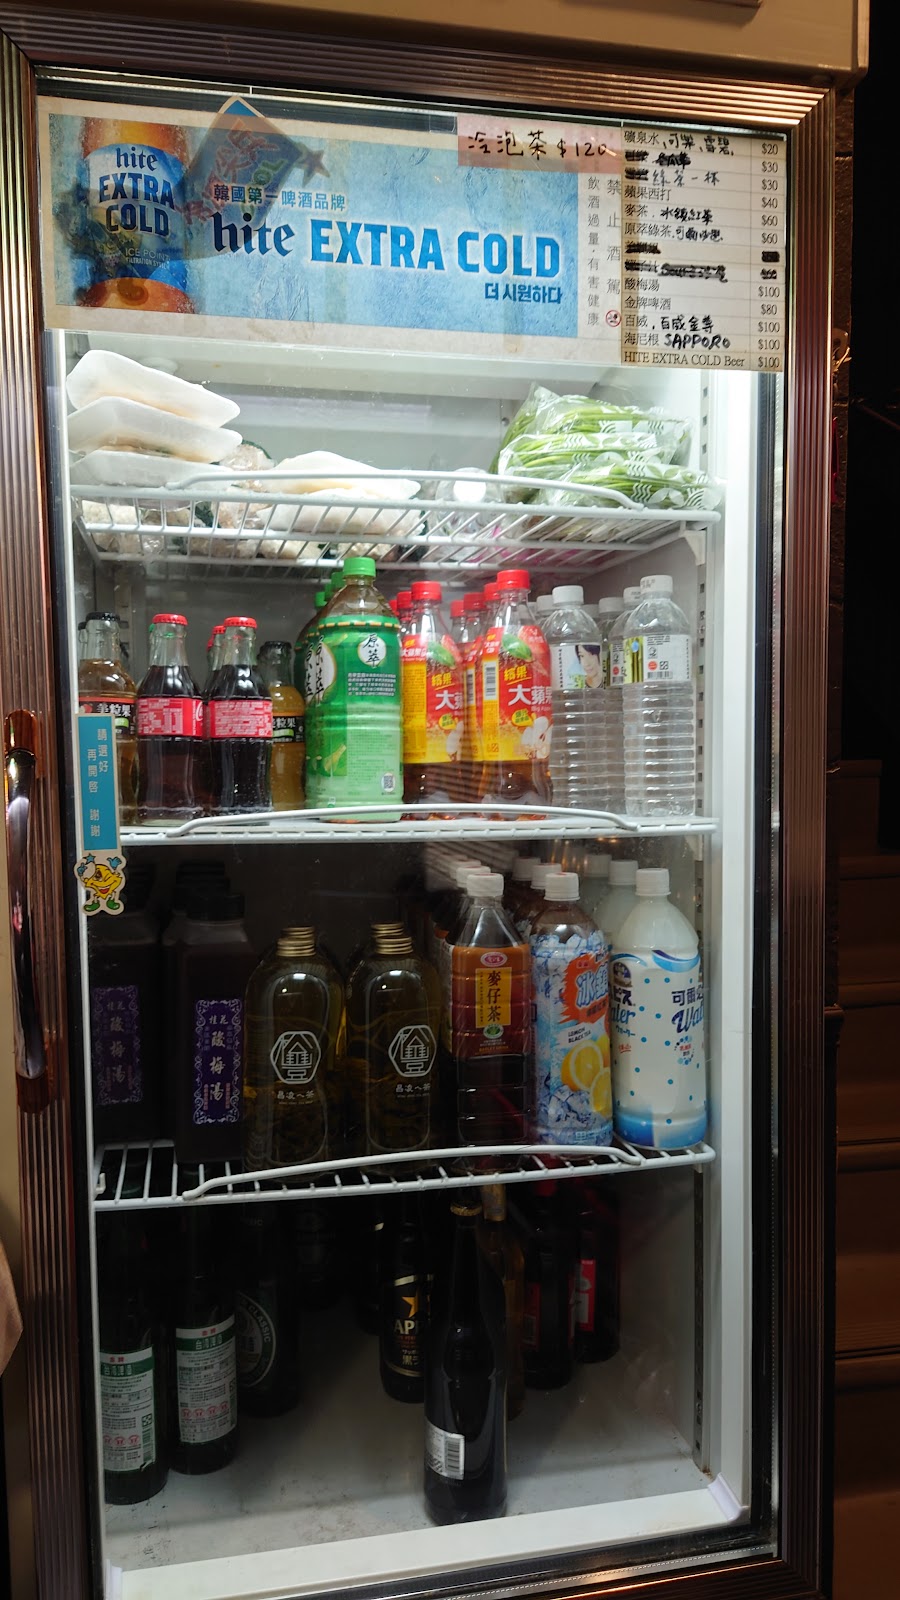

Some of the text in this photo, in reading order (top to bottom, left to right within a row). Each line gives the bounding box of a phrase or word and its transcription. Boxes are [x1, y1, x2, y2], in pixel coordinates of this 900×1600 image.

[761, 143, 779, 155] $20
[116, 146, 158, 171] hite
[761, 161, 779, 173] $30
[99, 172, 175, 210] EXTRA
[761, 179, 779, 191] $30
[213, 184, 346, 211] 韓國第一啤酒品牌
[624, 185, 671, 202] 蘋果西打
[761, 197, 779, 209] $40
[106, 203, 170, 237] COLD
[761, 215, 779, 227] $60
[211, 212, 560, 279] hite EXTRA COLD
[607, 179, 621, 296] 禁止酒駕
[761, 233, 779, 245] $60
[624, 278, 660, 292] 酸梅湯
[757, 286, 781, 298] $100
[484, 282, 563, 305] 더 시원하다
[624, 295, 672, 311] 金牌啤酒
[761, 303, 778, 315] $80
[757, 321, 781, 333] $100
[624, 332, 732, 350] 海尼根 SAPPORO
[757, 339, 781, 351] $100
[624, 351, 745, 367] HITE EXTRA COLD Beer
[757, 356, 780, 368] $100
[362, 633, 381, 668] 原萃
[487, 970, 502, 1022] 麥仔茶
[208, 1014, 229, 1025] 桂花
[209, 1030, 227, 1101] 酸梅湯
[248, 1305, 272, 1344] CLASSIC
